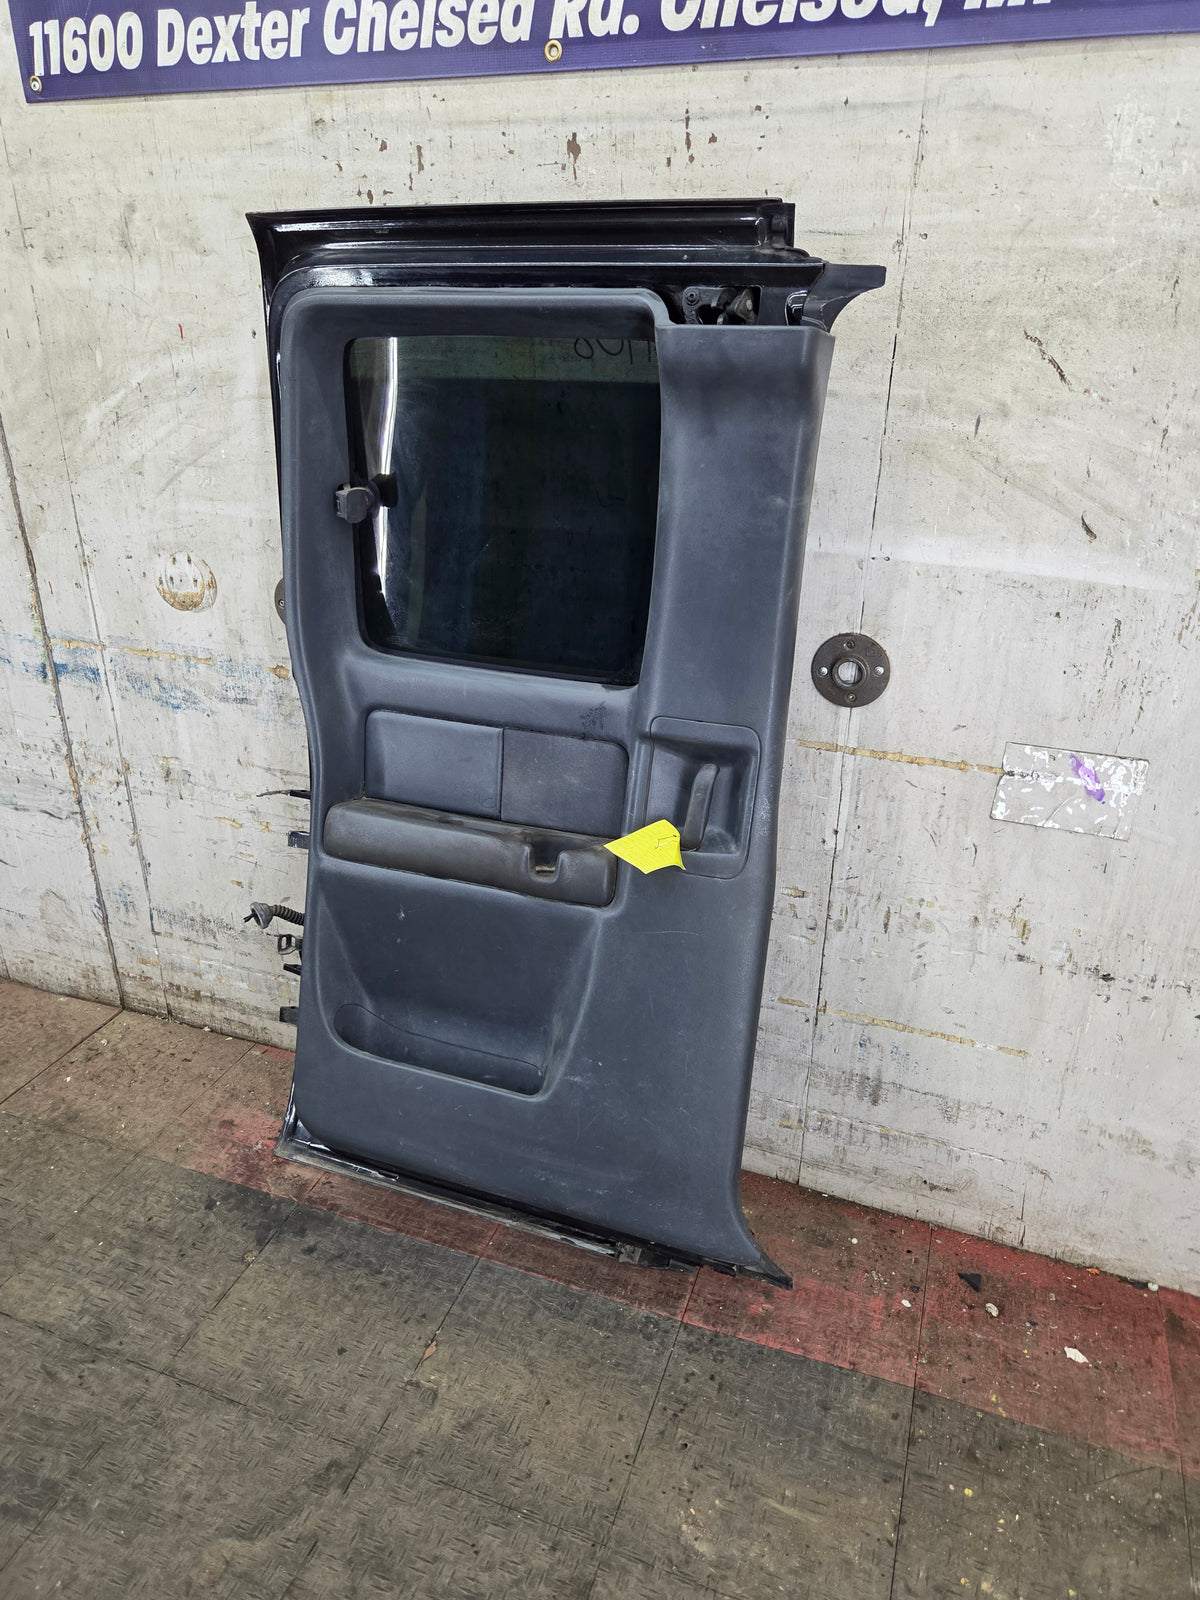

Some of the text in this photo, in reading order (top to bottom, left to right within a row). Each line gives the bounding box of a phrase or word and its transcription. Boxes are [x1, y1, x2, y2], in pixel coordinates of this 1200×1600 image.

[29, 11, 143, 76] 11600
[157, 1, 311, 67] Dexter
[323, 0, 535, 55] Chelsea
